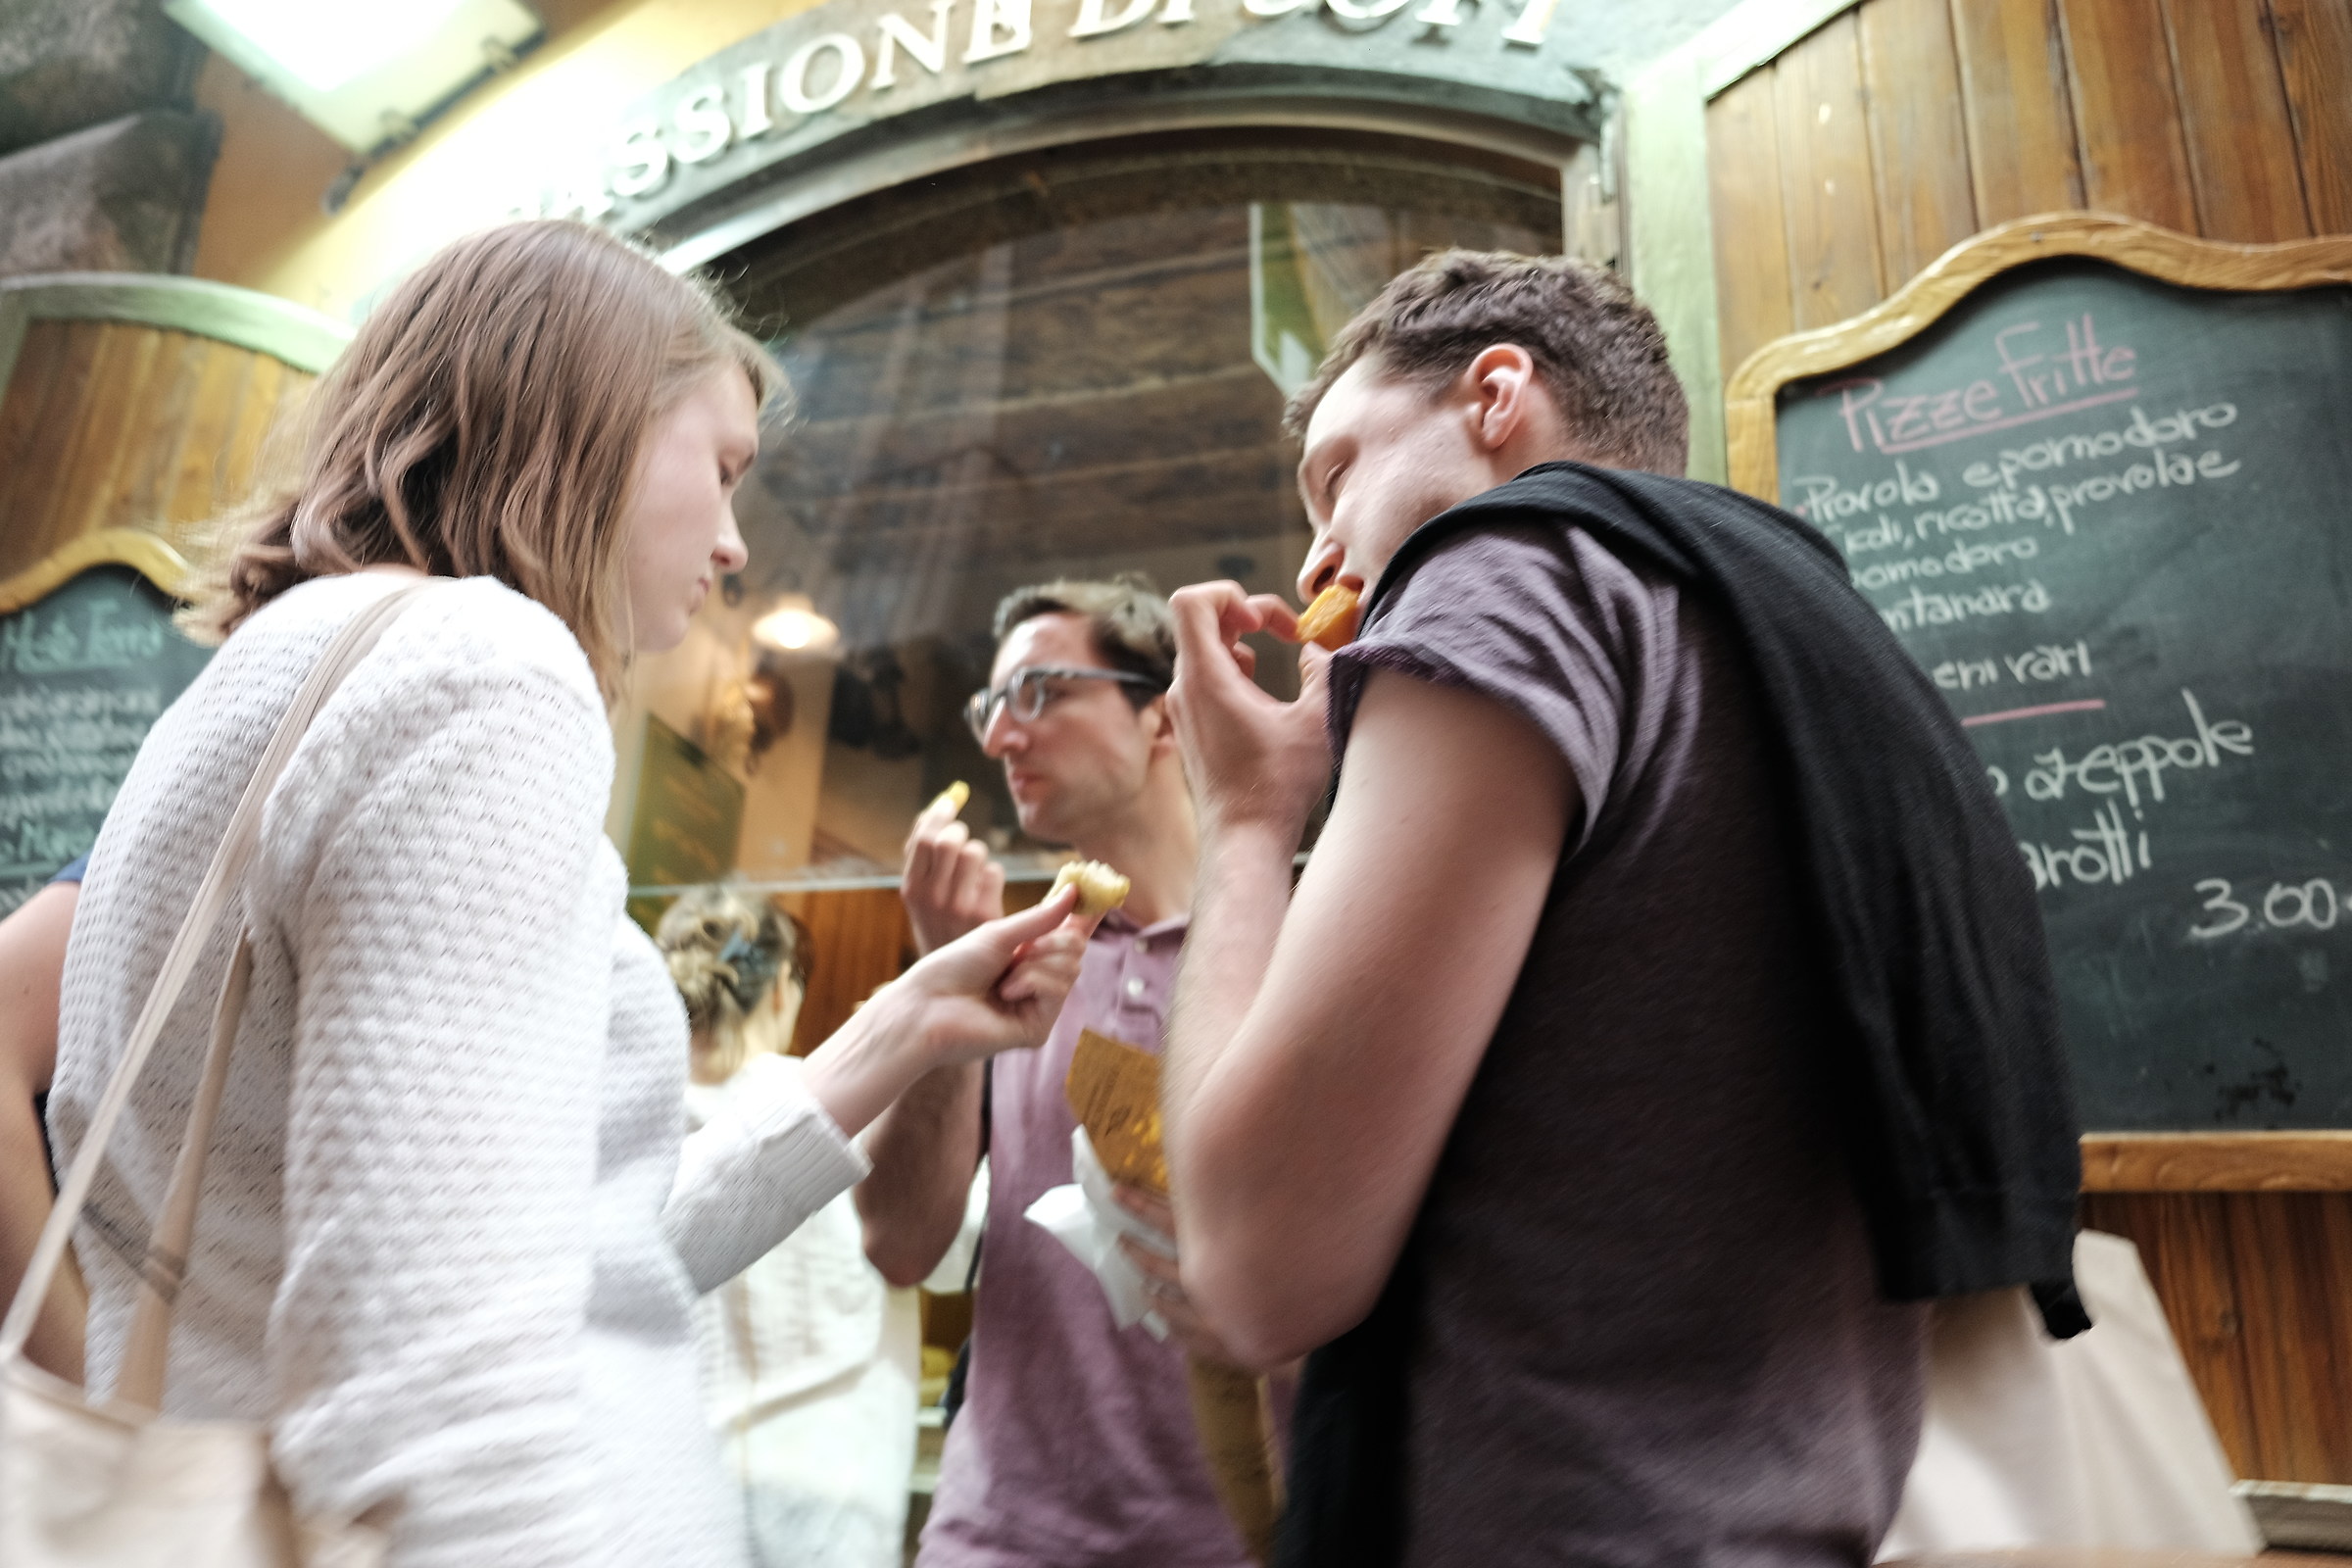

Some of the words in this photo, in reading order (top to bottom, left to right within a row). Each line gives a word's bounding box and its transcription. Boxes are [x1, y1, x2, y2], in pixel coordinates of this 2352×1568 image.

[519, 0, 1034, 218] SSIONE
[1816, 377, 2002, 453] Pizze
[1995, 313, 2136, 409] Fritte
[1850, 537, 2039, 591] omodoro
[1880, 579, 2052, 633] ntanara
[1933, 658, 1999, 691] eni
[2019, 798, 2152, 890] arotti
[2189, 878, 2338, 939] 3.00
